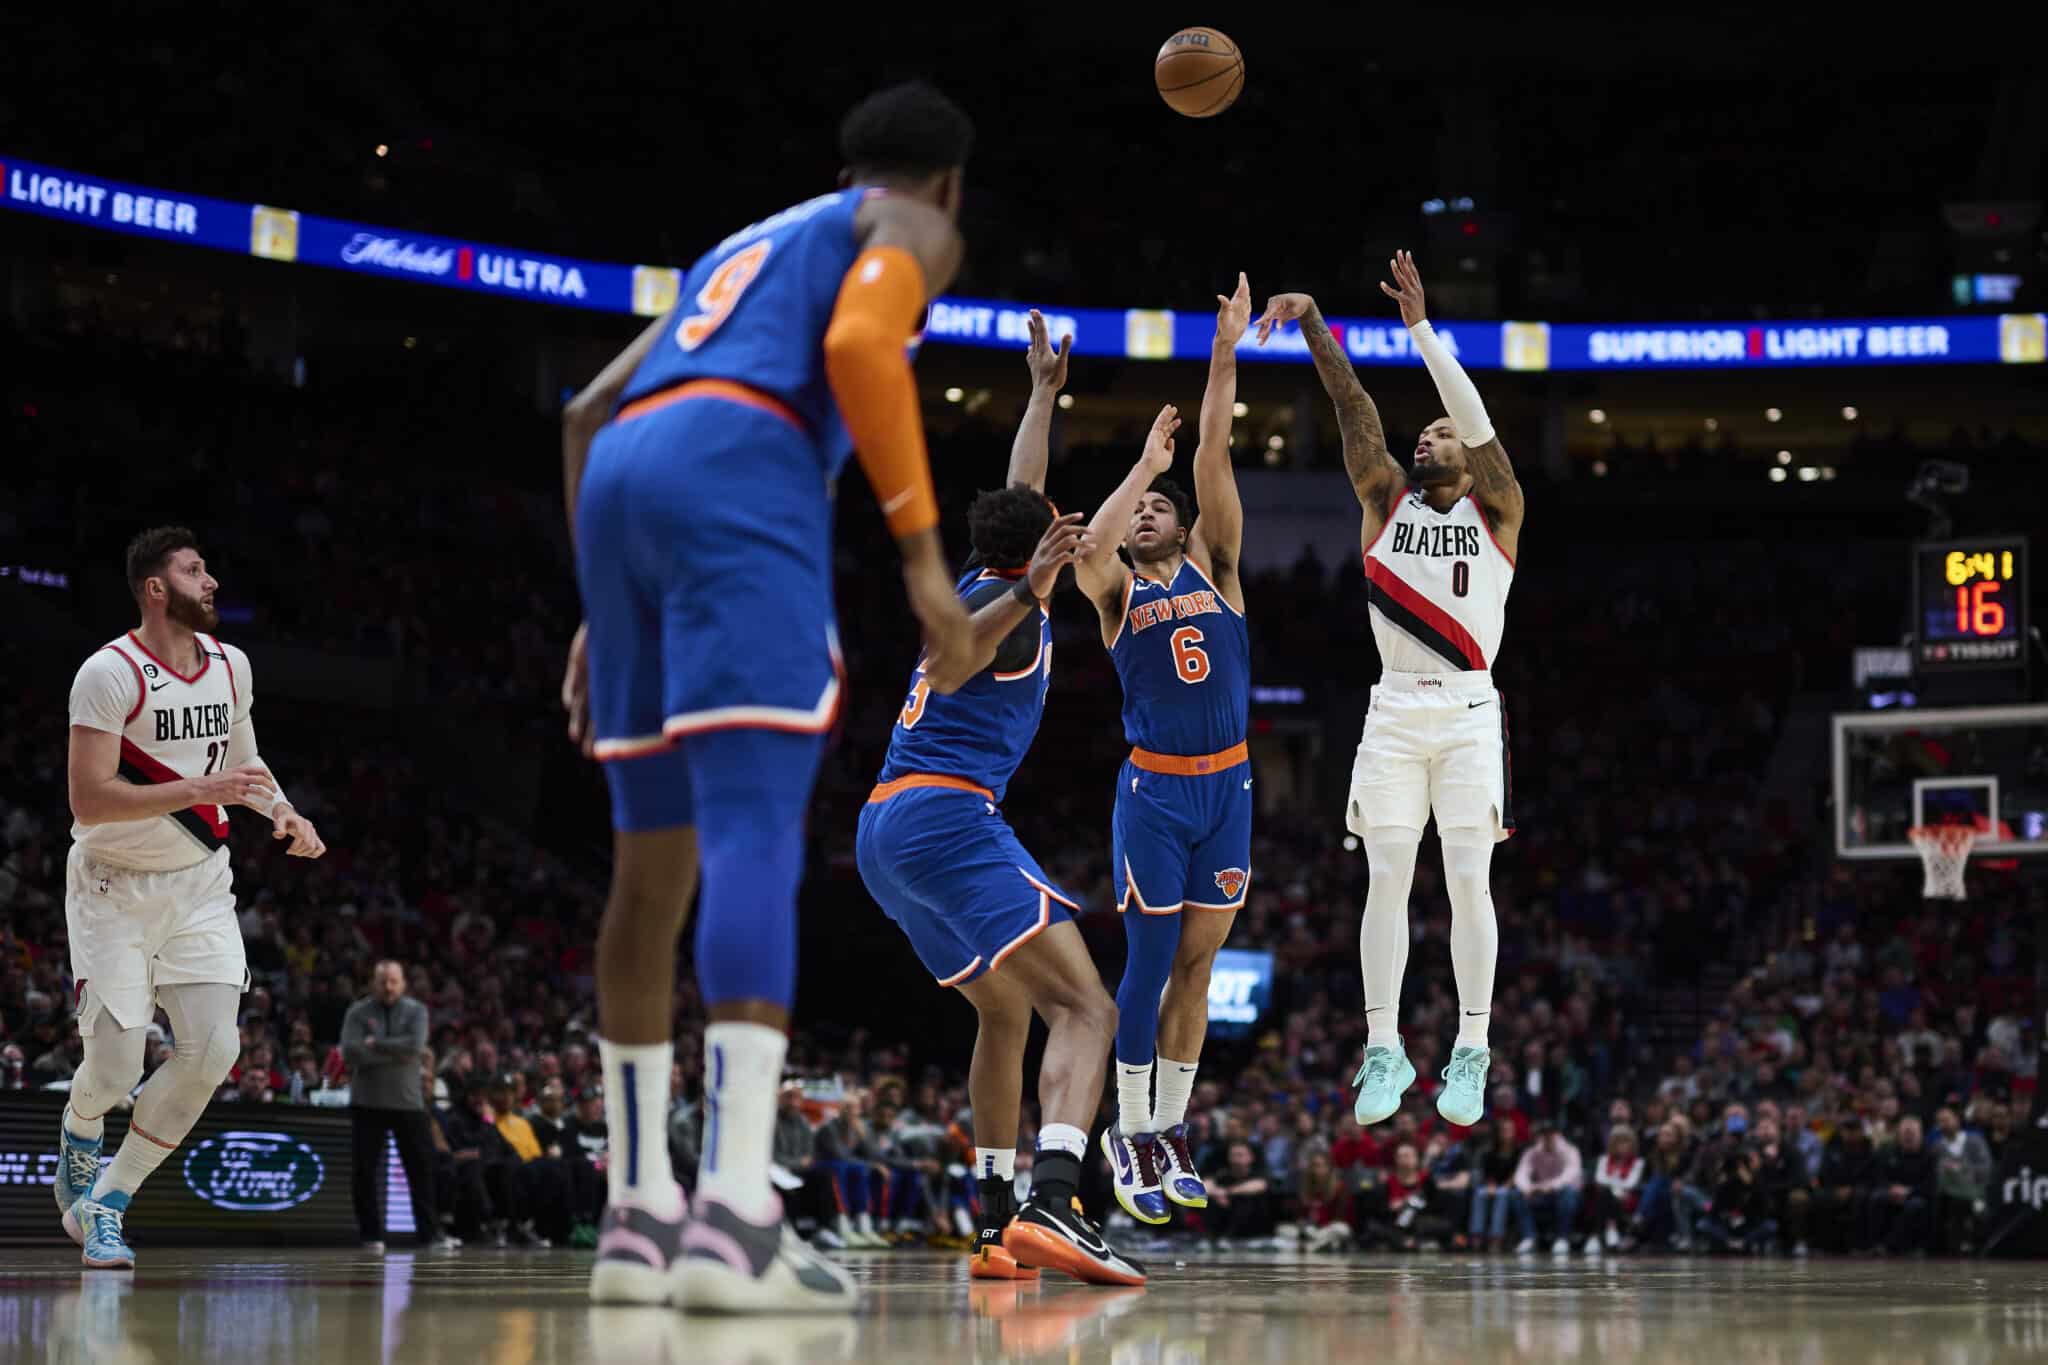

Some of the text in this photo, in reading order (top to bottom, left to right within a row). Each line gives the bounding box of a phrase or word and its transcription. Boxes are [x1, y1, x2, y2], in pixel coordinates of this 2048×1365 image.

[11, 169, 197, 234] LIGHT BEER
[478, 253, 587, 298] ULTRA
[675, 238, 773, 352] 9
[1590, 325, 1949, 362] SUPERIOR LIGHT BEER
[1391, 522, 1480, 558] BLAZERS
[1451, 560, 1470, 598] 0
[1129, 590, 1223, 635] NEW YORK
[1957, 581, 2005, 636] 16
[1170, 625, 1211, 684] 6
[153, 703, 230, 742] BLAZERS
[981, 1228, 1000, 1239] GT
